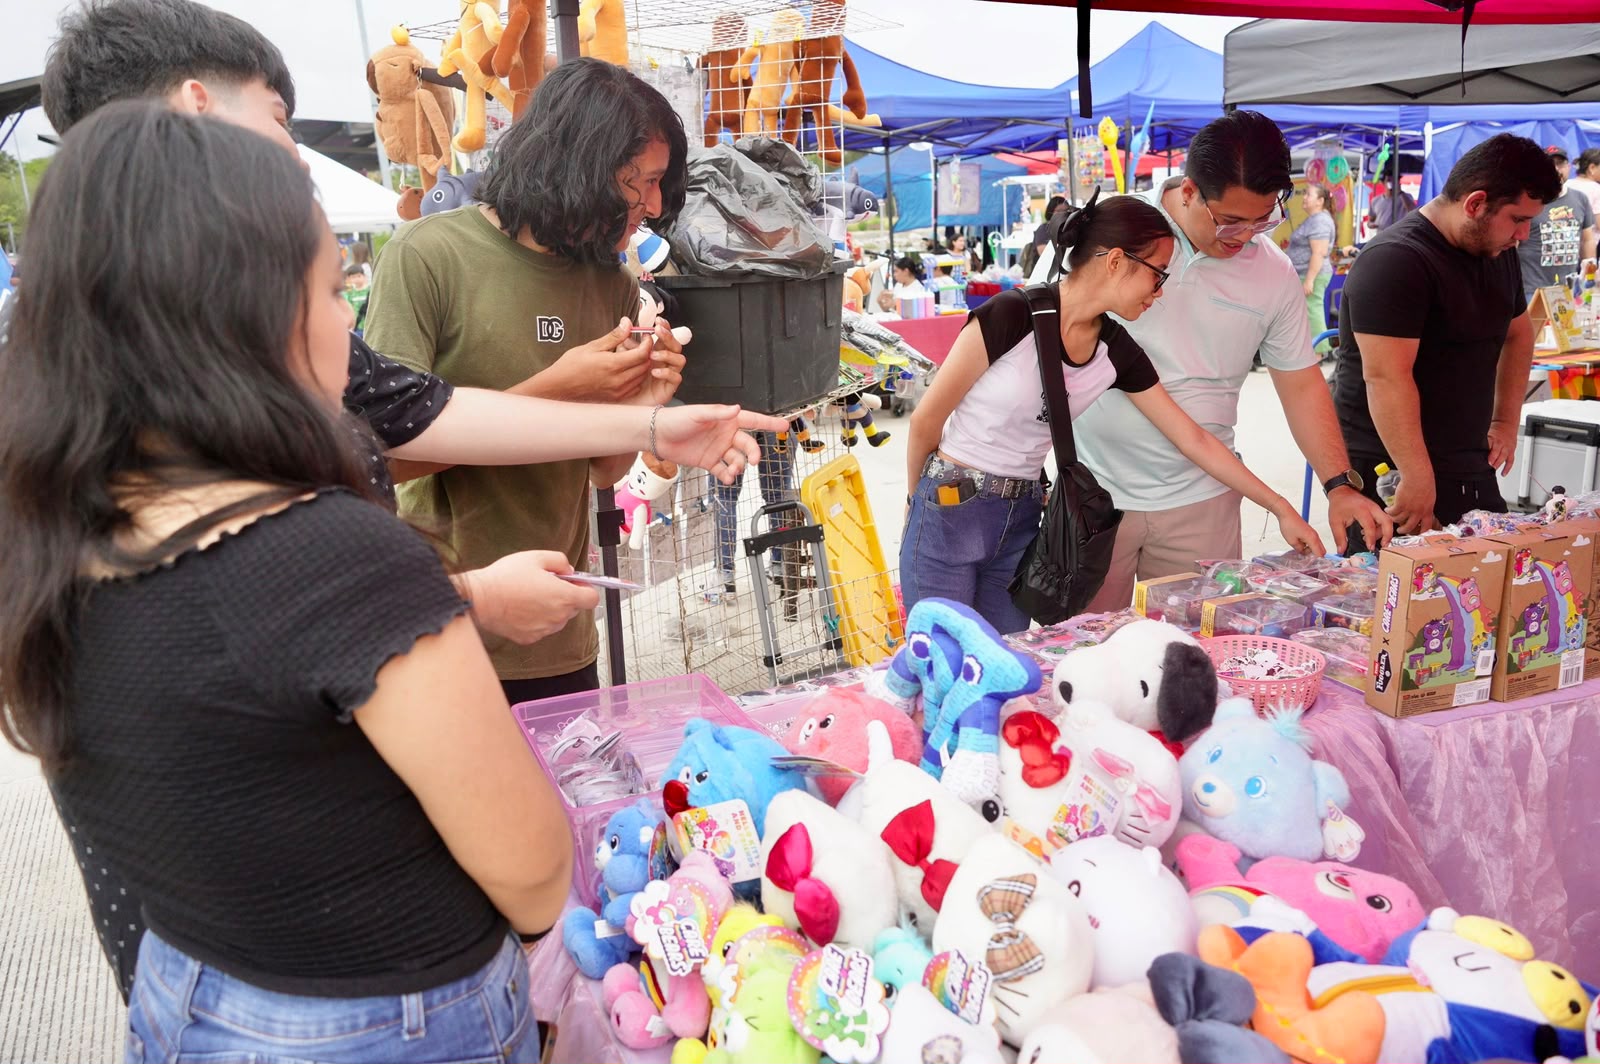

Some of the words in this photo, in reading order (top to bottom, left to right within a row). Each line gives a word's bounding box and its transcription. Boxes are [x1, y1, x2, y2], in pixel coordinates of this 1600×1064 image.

[1382, 603, 1393, 633] CARE
[1388, 573, 1399, 609] BEARS
[732, 812, 741, 830] AND
[658, 927, 688, 973] BEARS
[680, 920, 708, 959] CARE
[822, 945, 845, 993] CARE
[844, 951, 870, 1009] BEARS
[947, 949, 968, 1001] CARE
